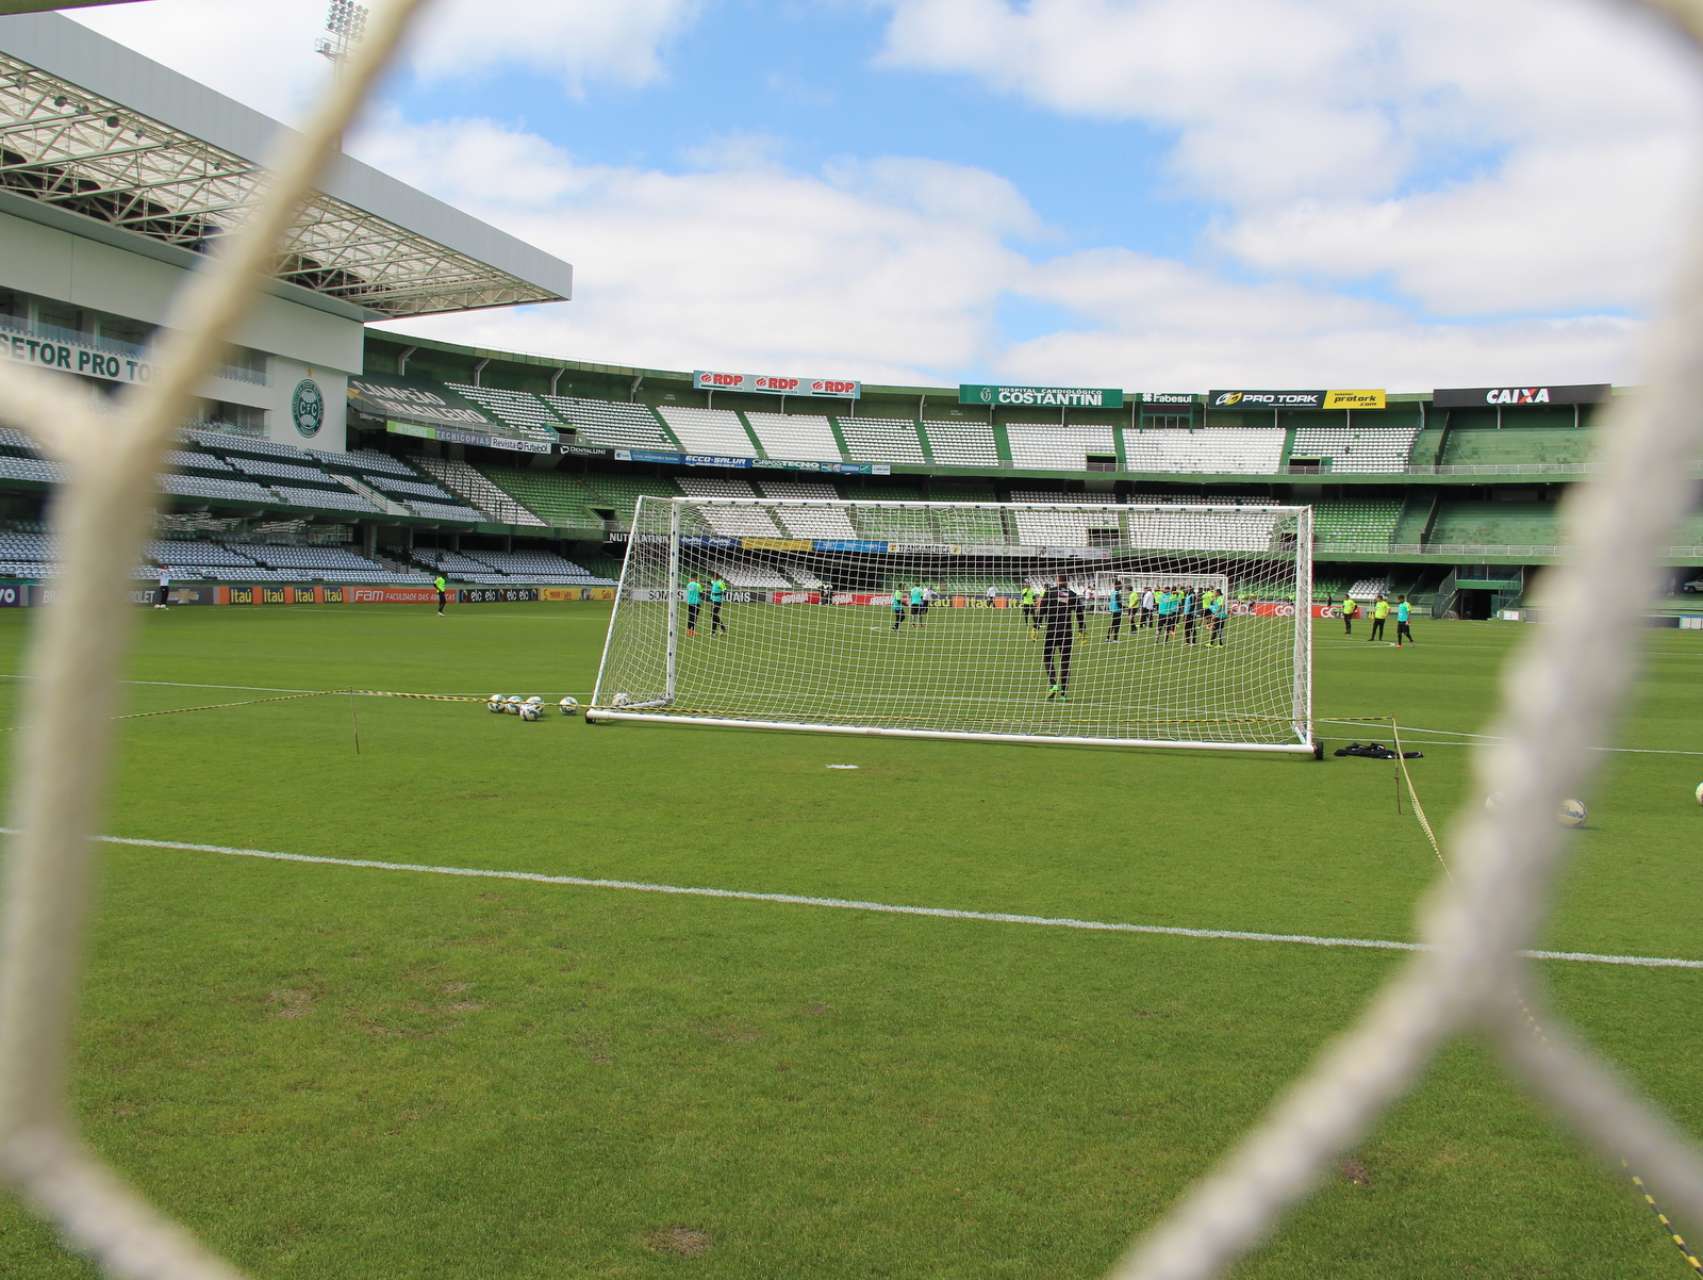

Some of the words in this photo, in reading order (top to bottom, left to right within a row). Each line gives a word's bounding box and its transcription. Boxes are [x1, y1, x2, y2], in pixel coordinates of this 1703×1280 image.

[0, 333, 70, 369] SETOR
[78, 350, 120, 378] PRO
[713, 374, 744, 385] RDP
[768, 377, 799, 389] RDP
[824, 381, 855, 392] RDP
[998, 392, 1103, 406] COSTANTINI
[1153, 393, 1192, 404] Fabesul
[1243, 394, 1275, 403] PRO
[1278, 394, 1319, 403] TORK
[1486, 388, 1550, 405] CAIXA
[231, 588, 252, 603] Itaú
[264, 588, 284, 603] Itaú
[295, 588, 314, 602] Itaú
[325, 588, 342, 602] Itaú
